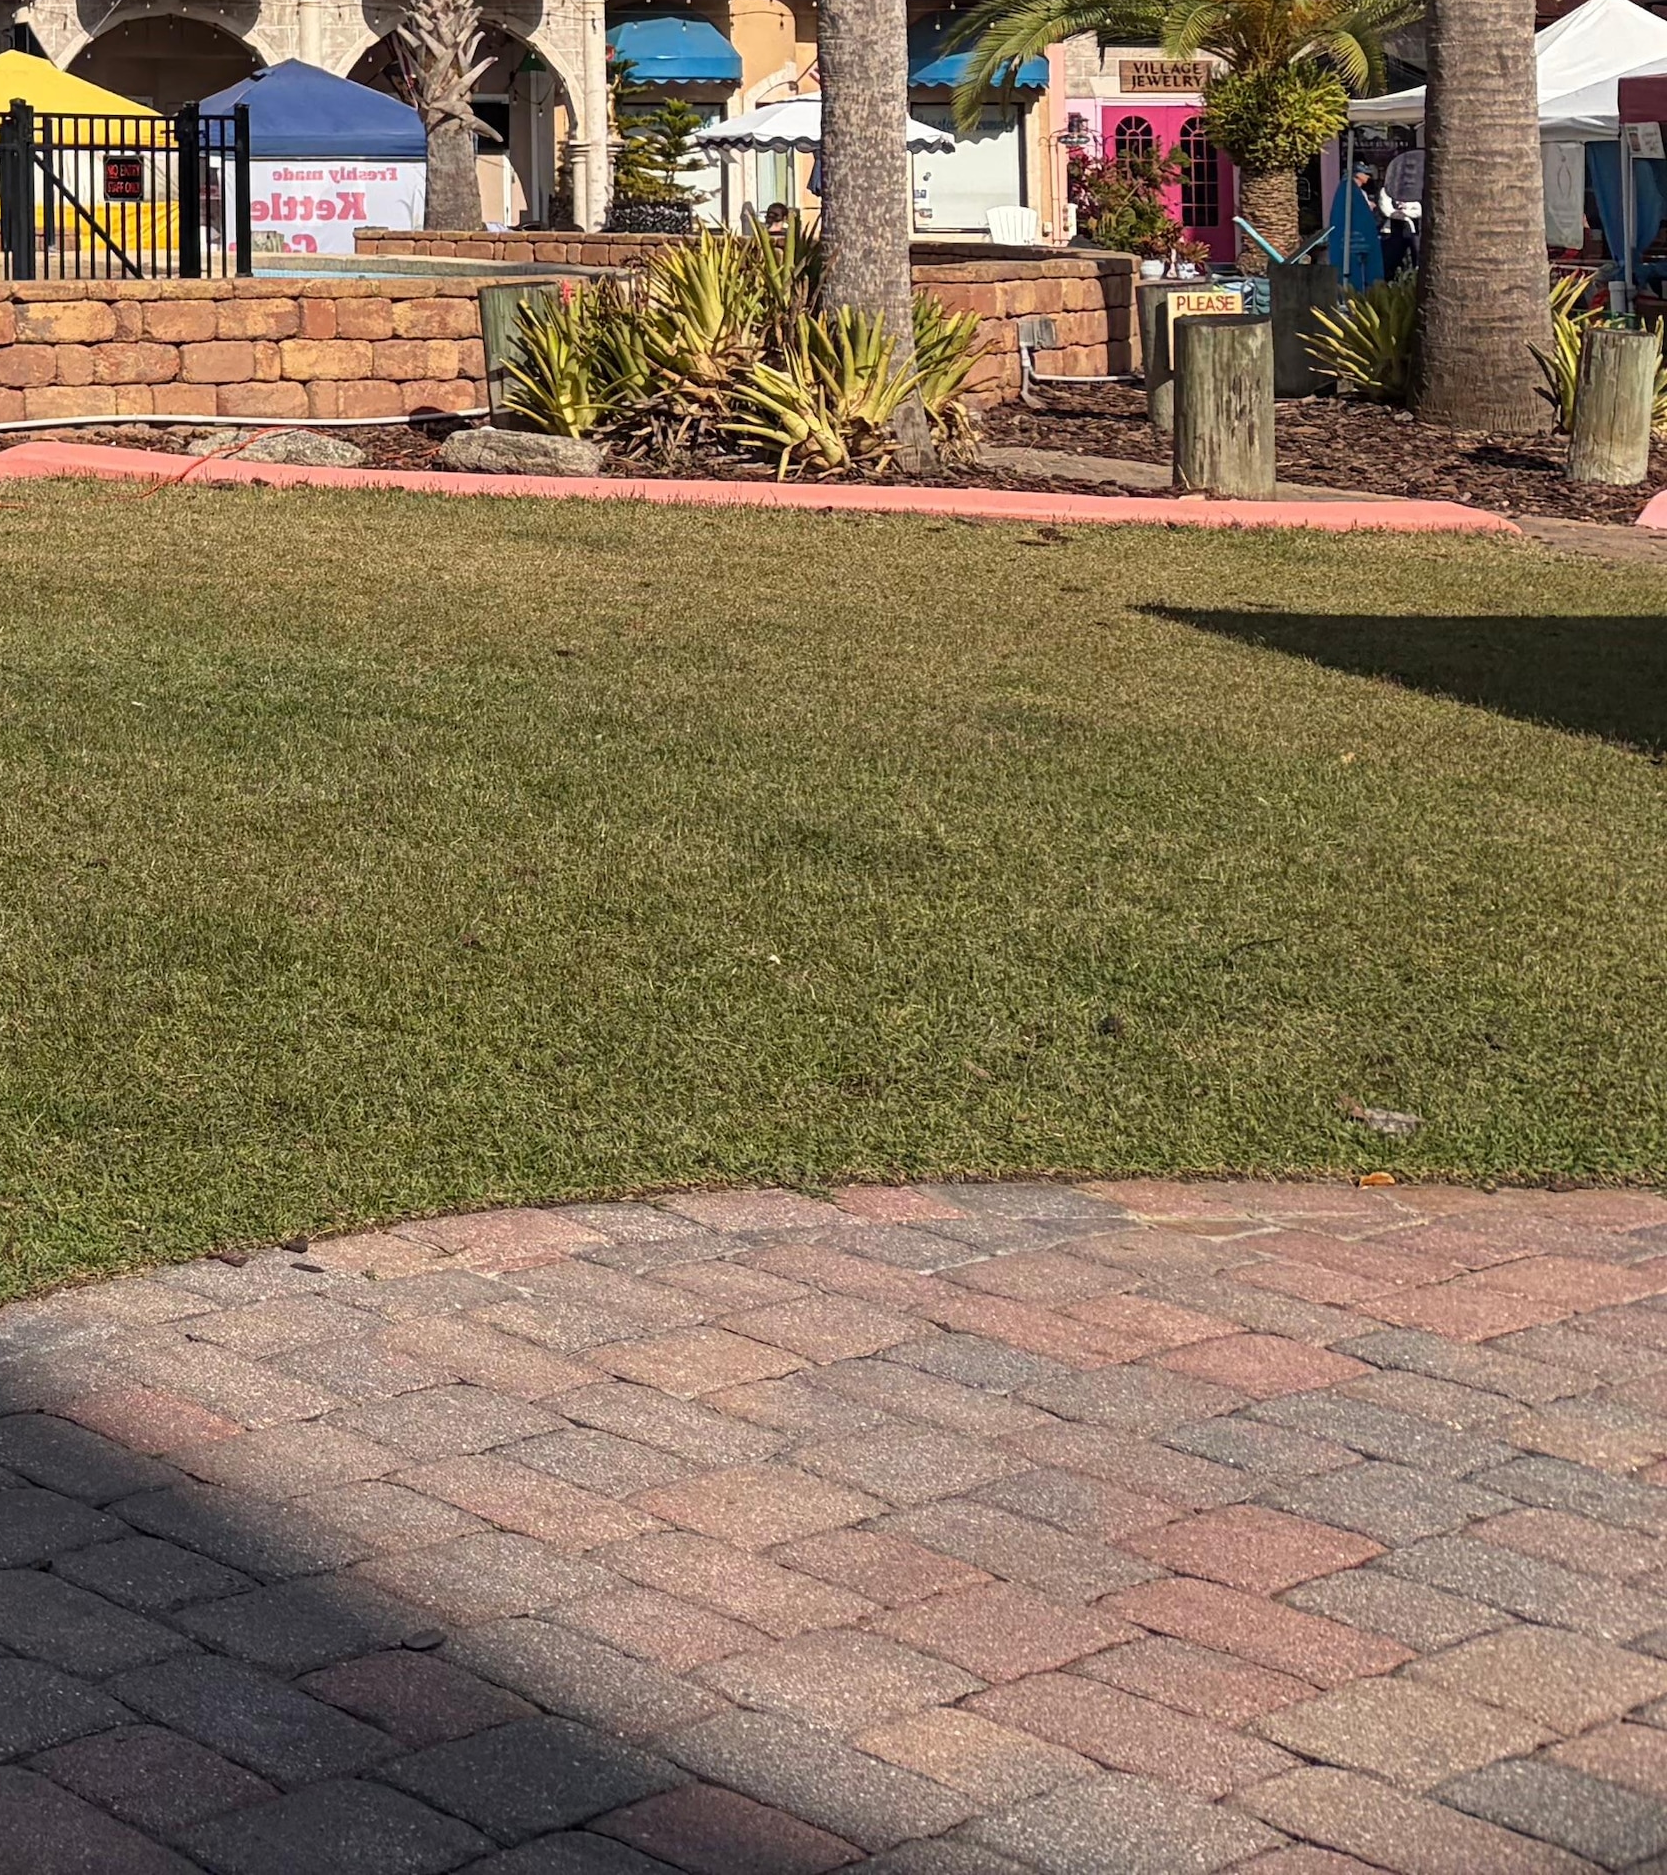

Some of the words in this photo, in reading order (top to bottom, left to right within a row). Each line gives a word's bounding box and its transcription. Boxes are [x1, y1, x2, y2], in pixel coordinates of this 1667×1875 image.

[1133, 62, 1202, 75] VILLAGE
[1132, 75, 1204, 90] JEWELRY
[1176, 294, 1235, 312] PLEASE
